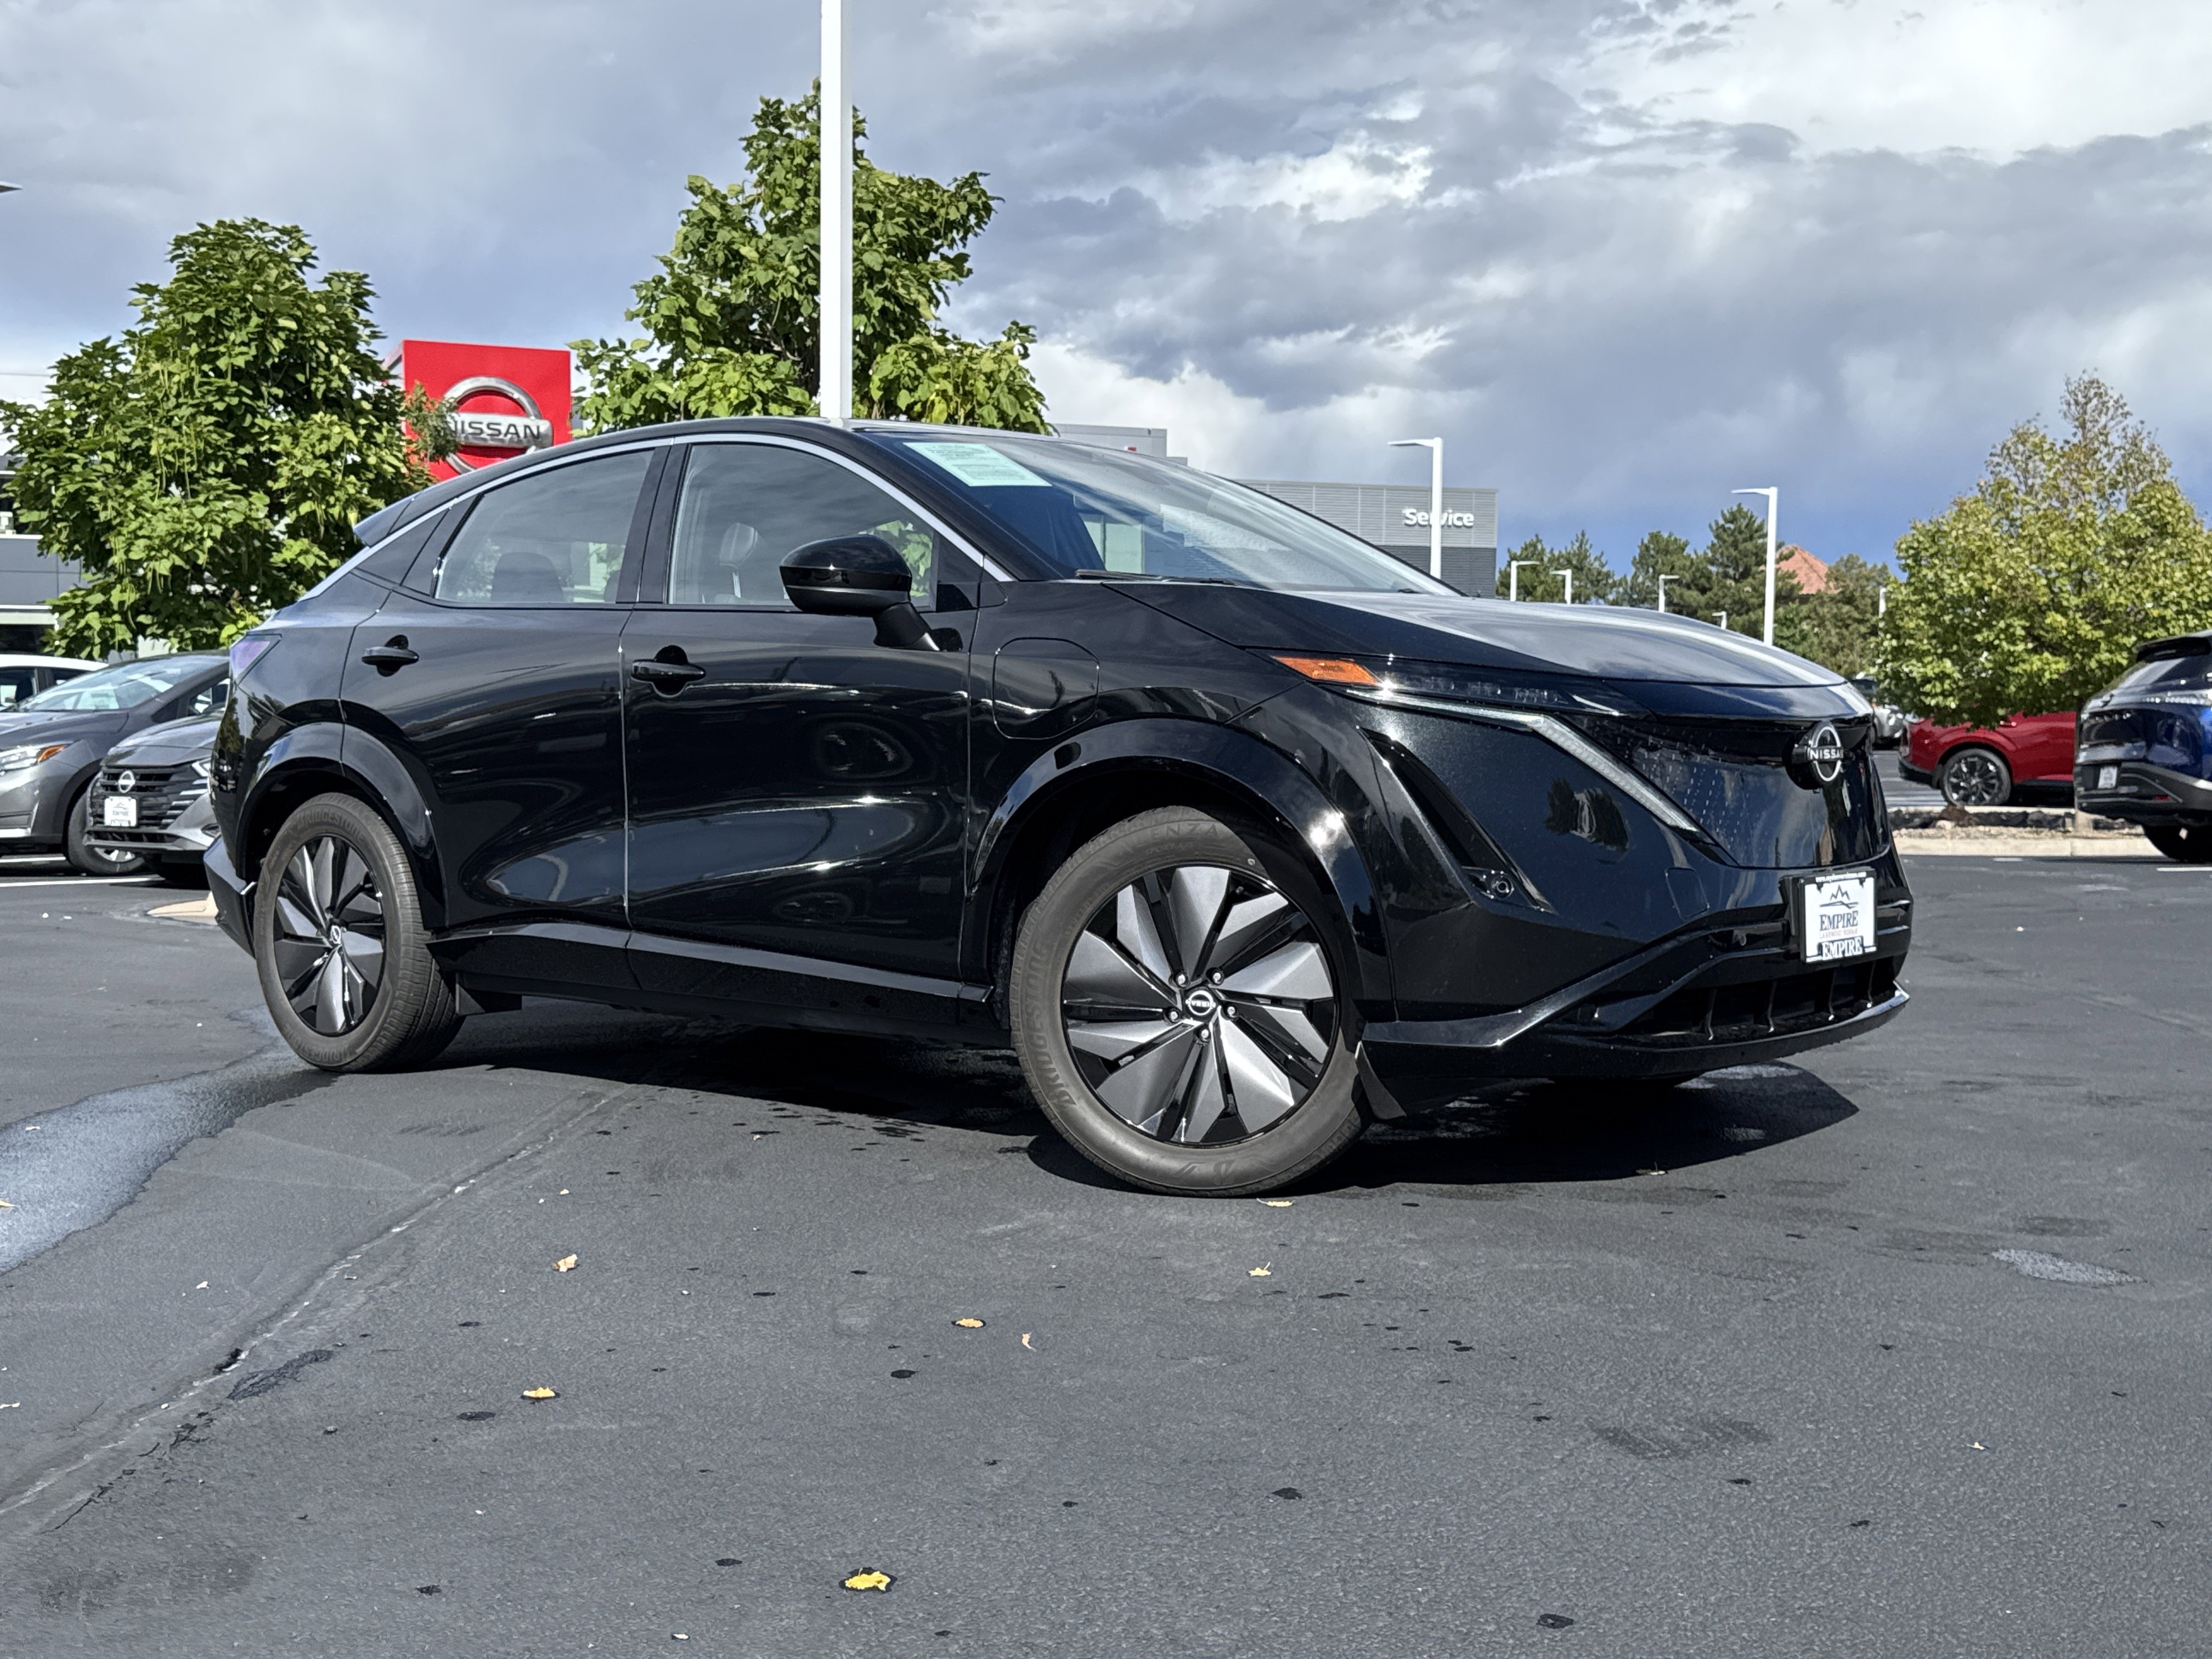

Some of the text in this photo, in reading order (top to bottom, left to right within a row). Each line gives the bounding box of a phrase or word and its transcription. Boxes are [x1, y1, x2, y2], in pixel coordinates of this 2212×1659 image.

[1403, 507, 1475, 526] Sevice
[1819, 910, 1858, 931] EMPIRE
[1821, 936, 1863, 960] EMPIRE
[1023, 941, 1077, 1106] BRIDGESTONE
